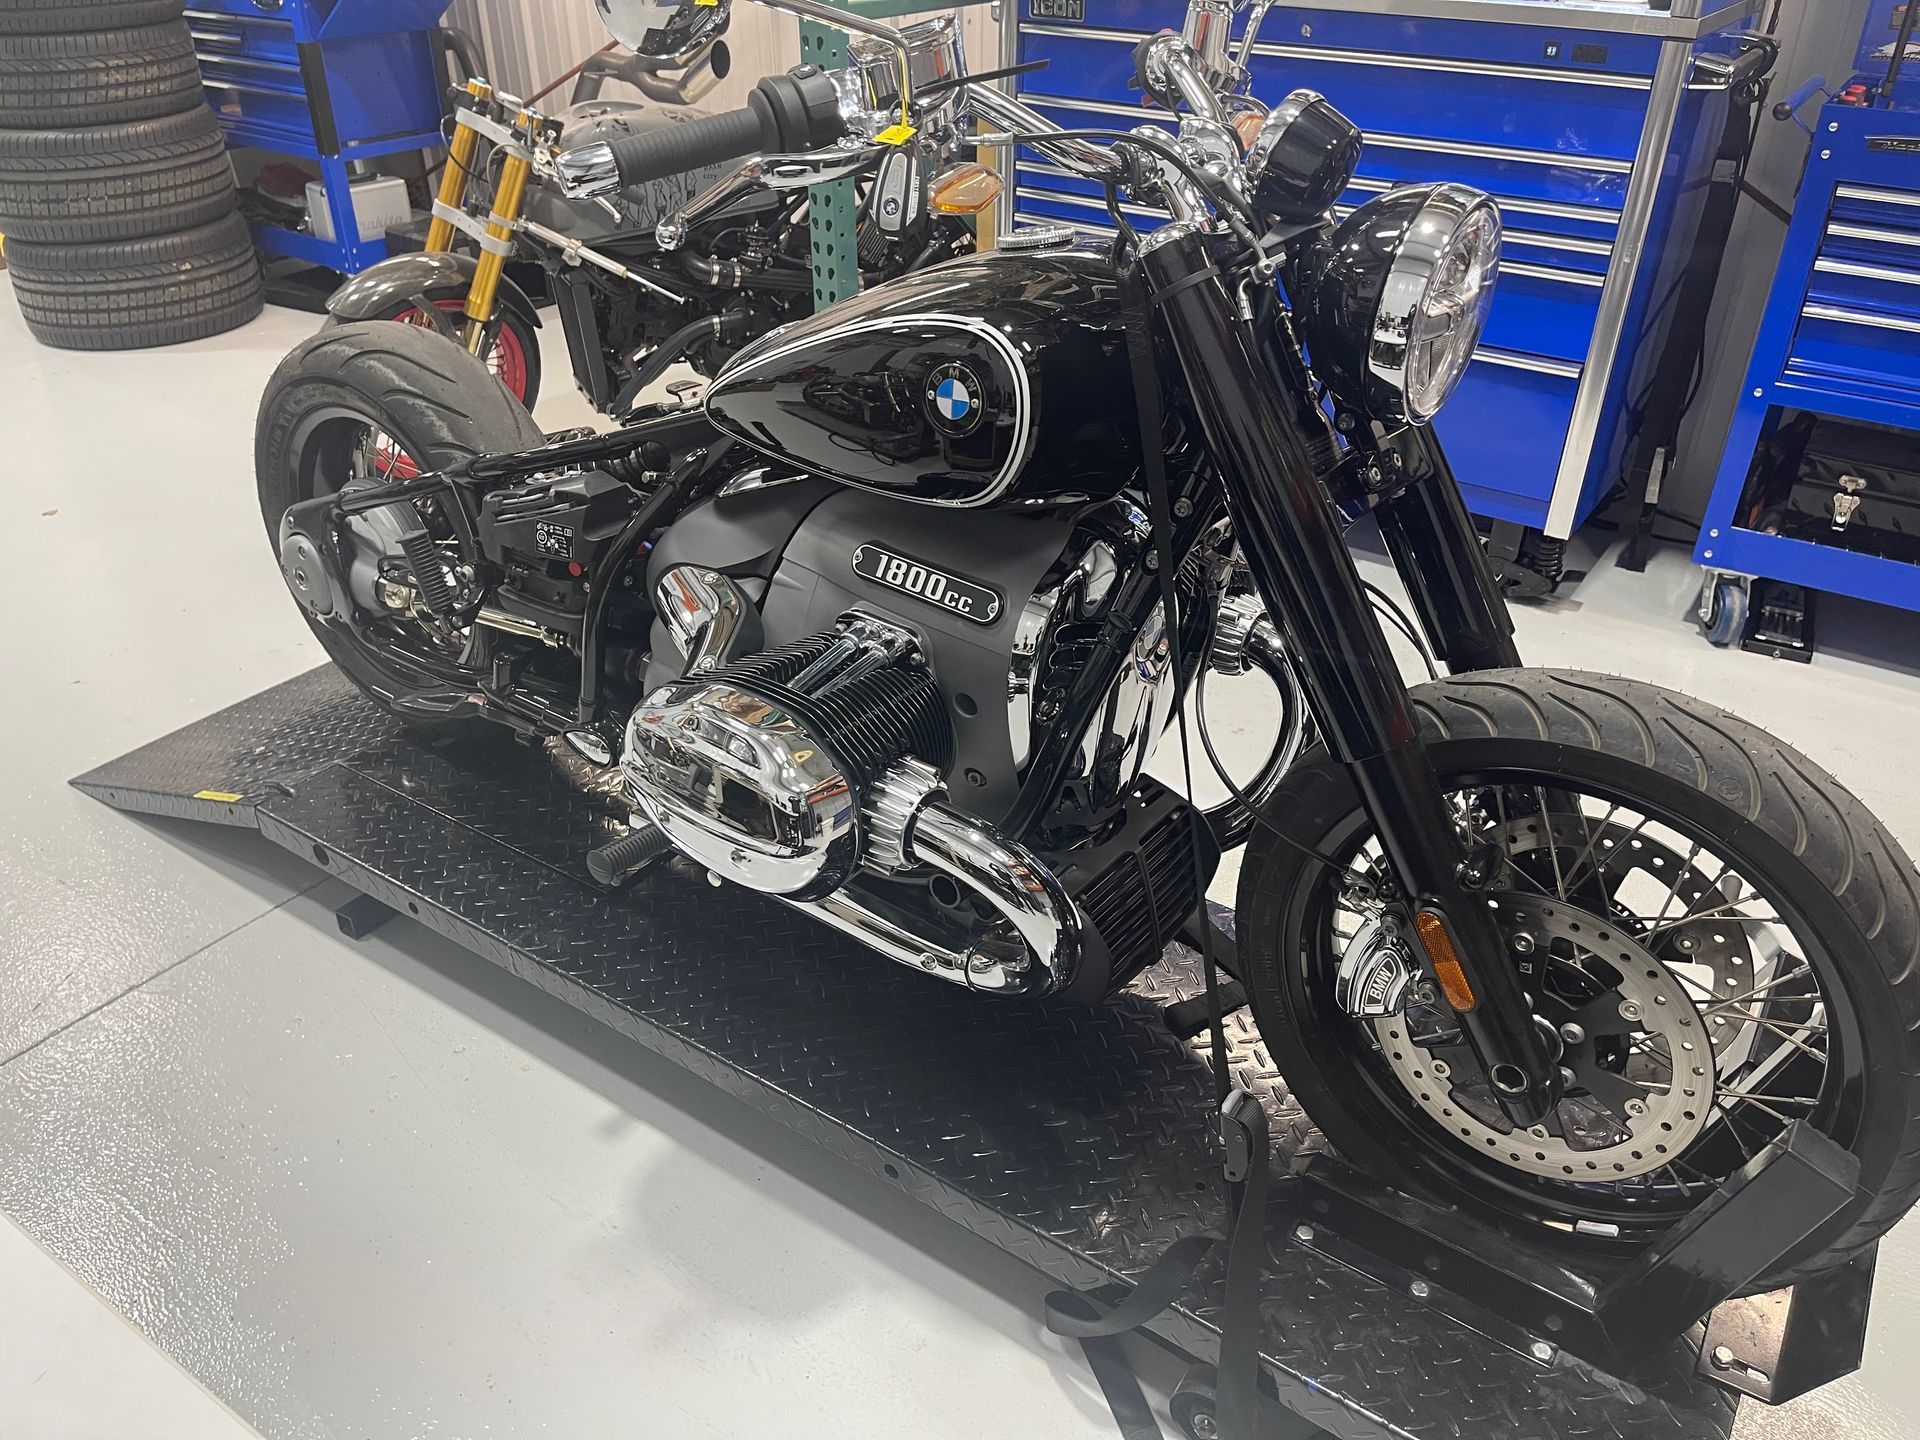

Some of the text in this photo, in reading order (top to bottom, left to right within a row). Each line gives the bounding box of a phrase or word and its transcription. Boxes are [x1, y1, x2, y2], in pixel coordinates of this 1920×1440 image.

[1033, 0, 1081, 18] ICON
[932, 367, 977, 392] BMW
[1369, 966, 1393, 1000] BMW
